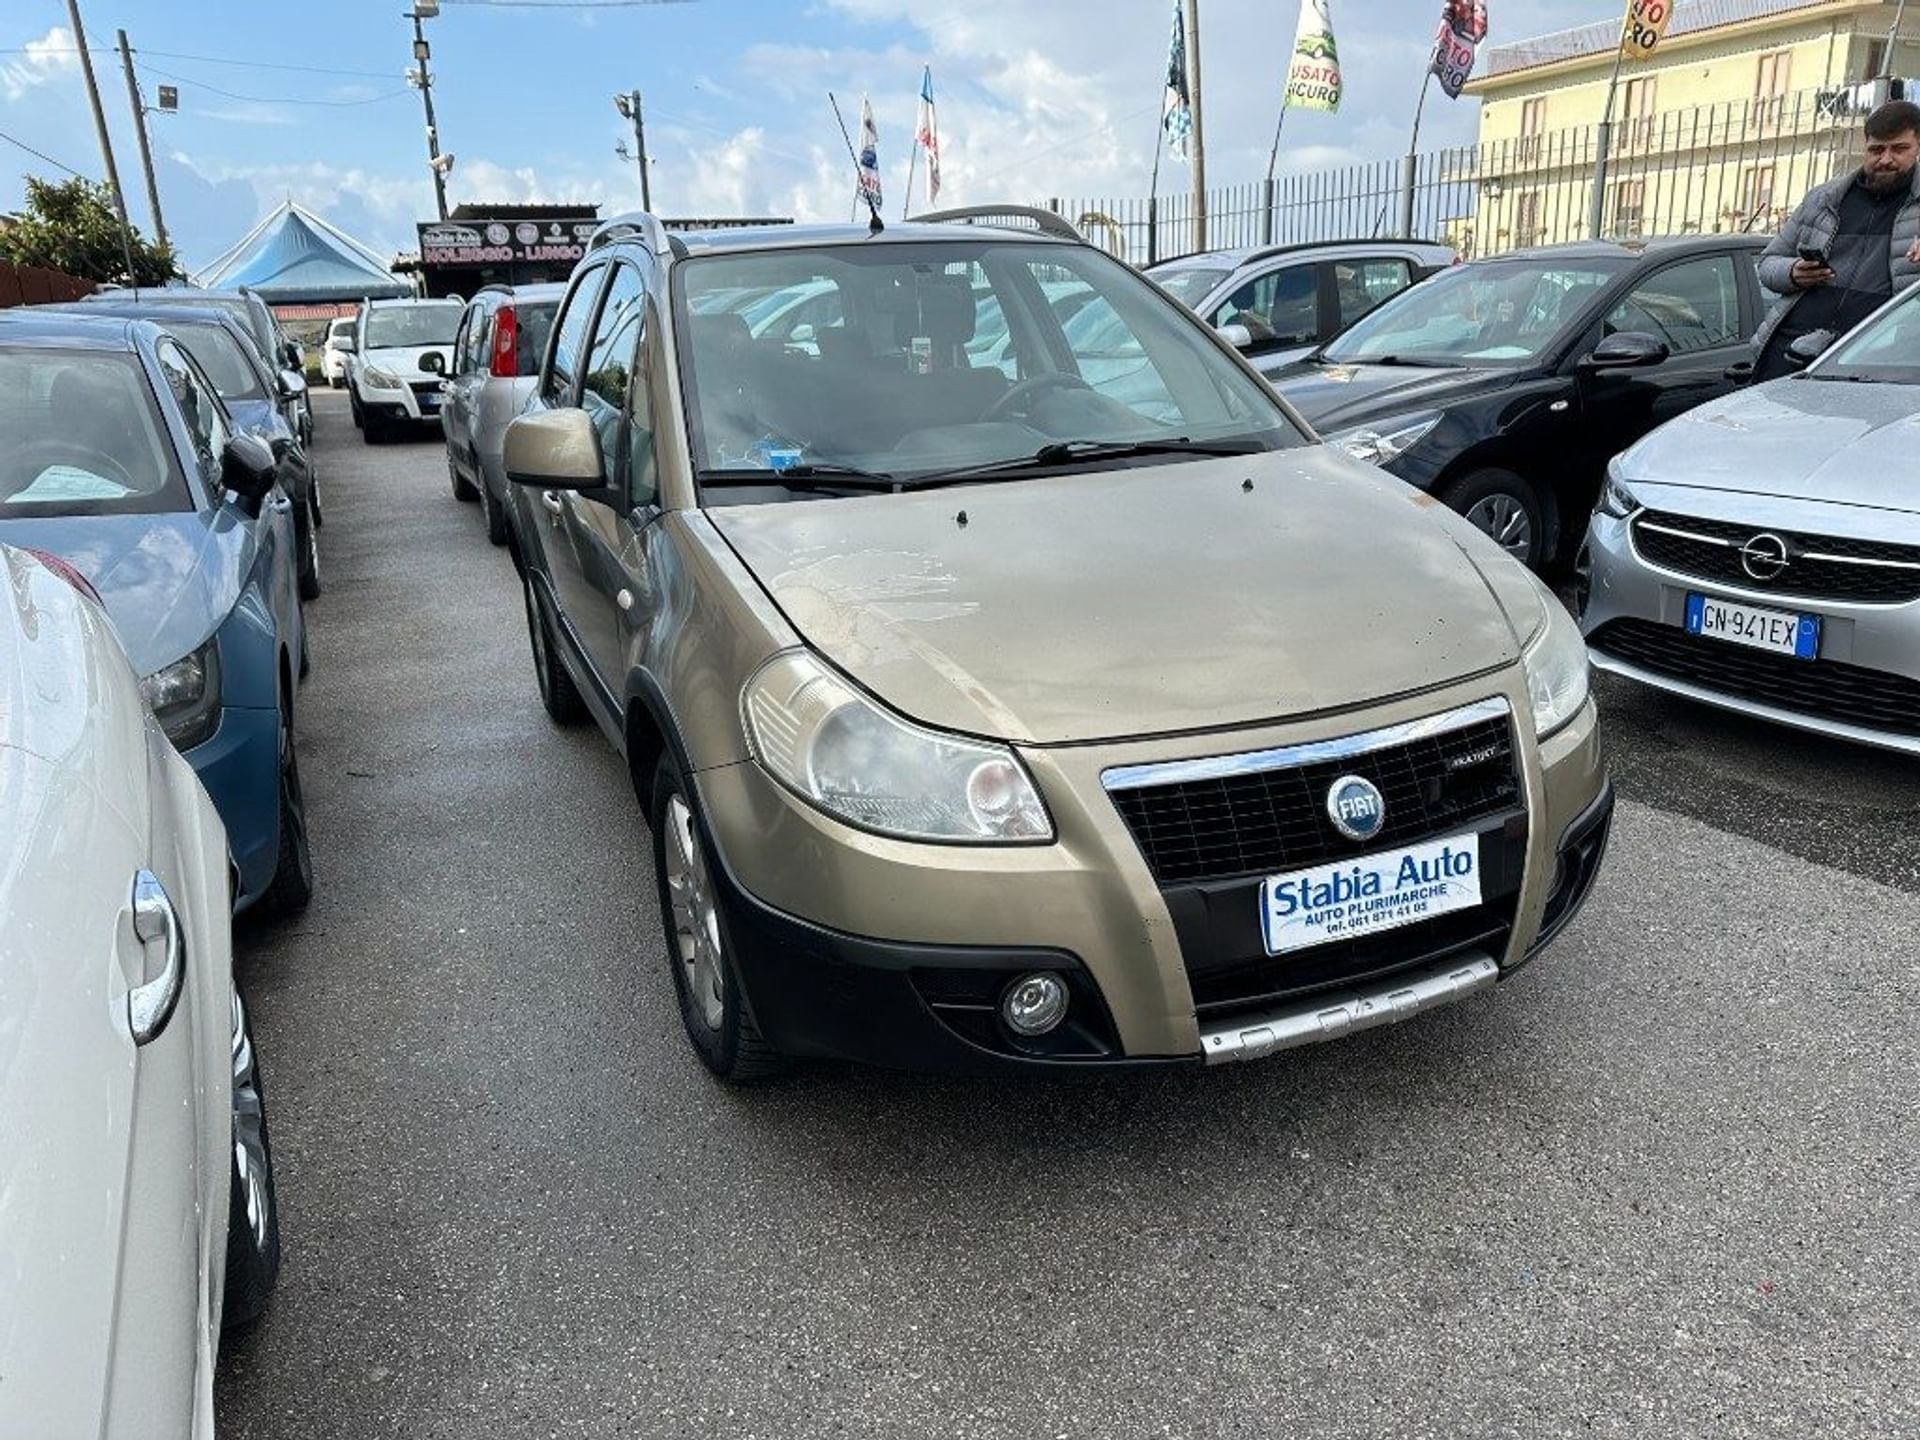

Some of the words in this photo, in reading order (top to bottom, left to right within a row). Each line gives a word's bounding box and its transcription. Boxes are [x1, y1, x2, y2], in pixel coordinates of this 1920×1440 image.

[1291, 65, 1340, 87] USATO
[525, 245, 583, 260] LUNGO
[1338, 794, 1377, 820] FIAT
[1274, 865, 1381, 917] Stabia
[1396, 846, 1472, 891] Auto
[1304, 907, 1345, 927] AUTO
[1348, 883, 1449, 917] PLURIMARCHE
